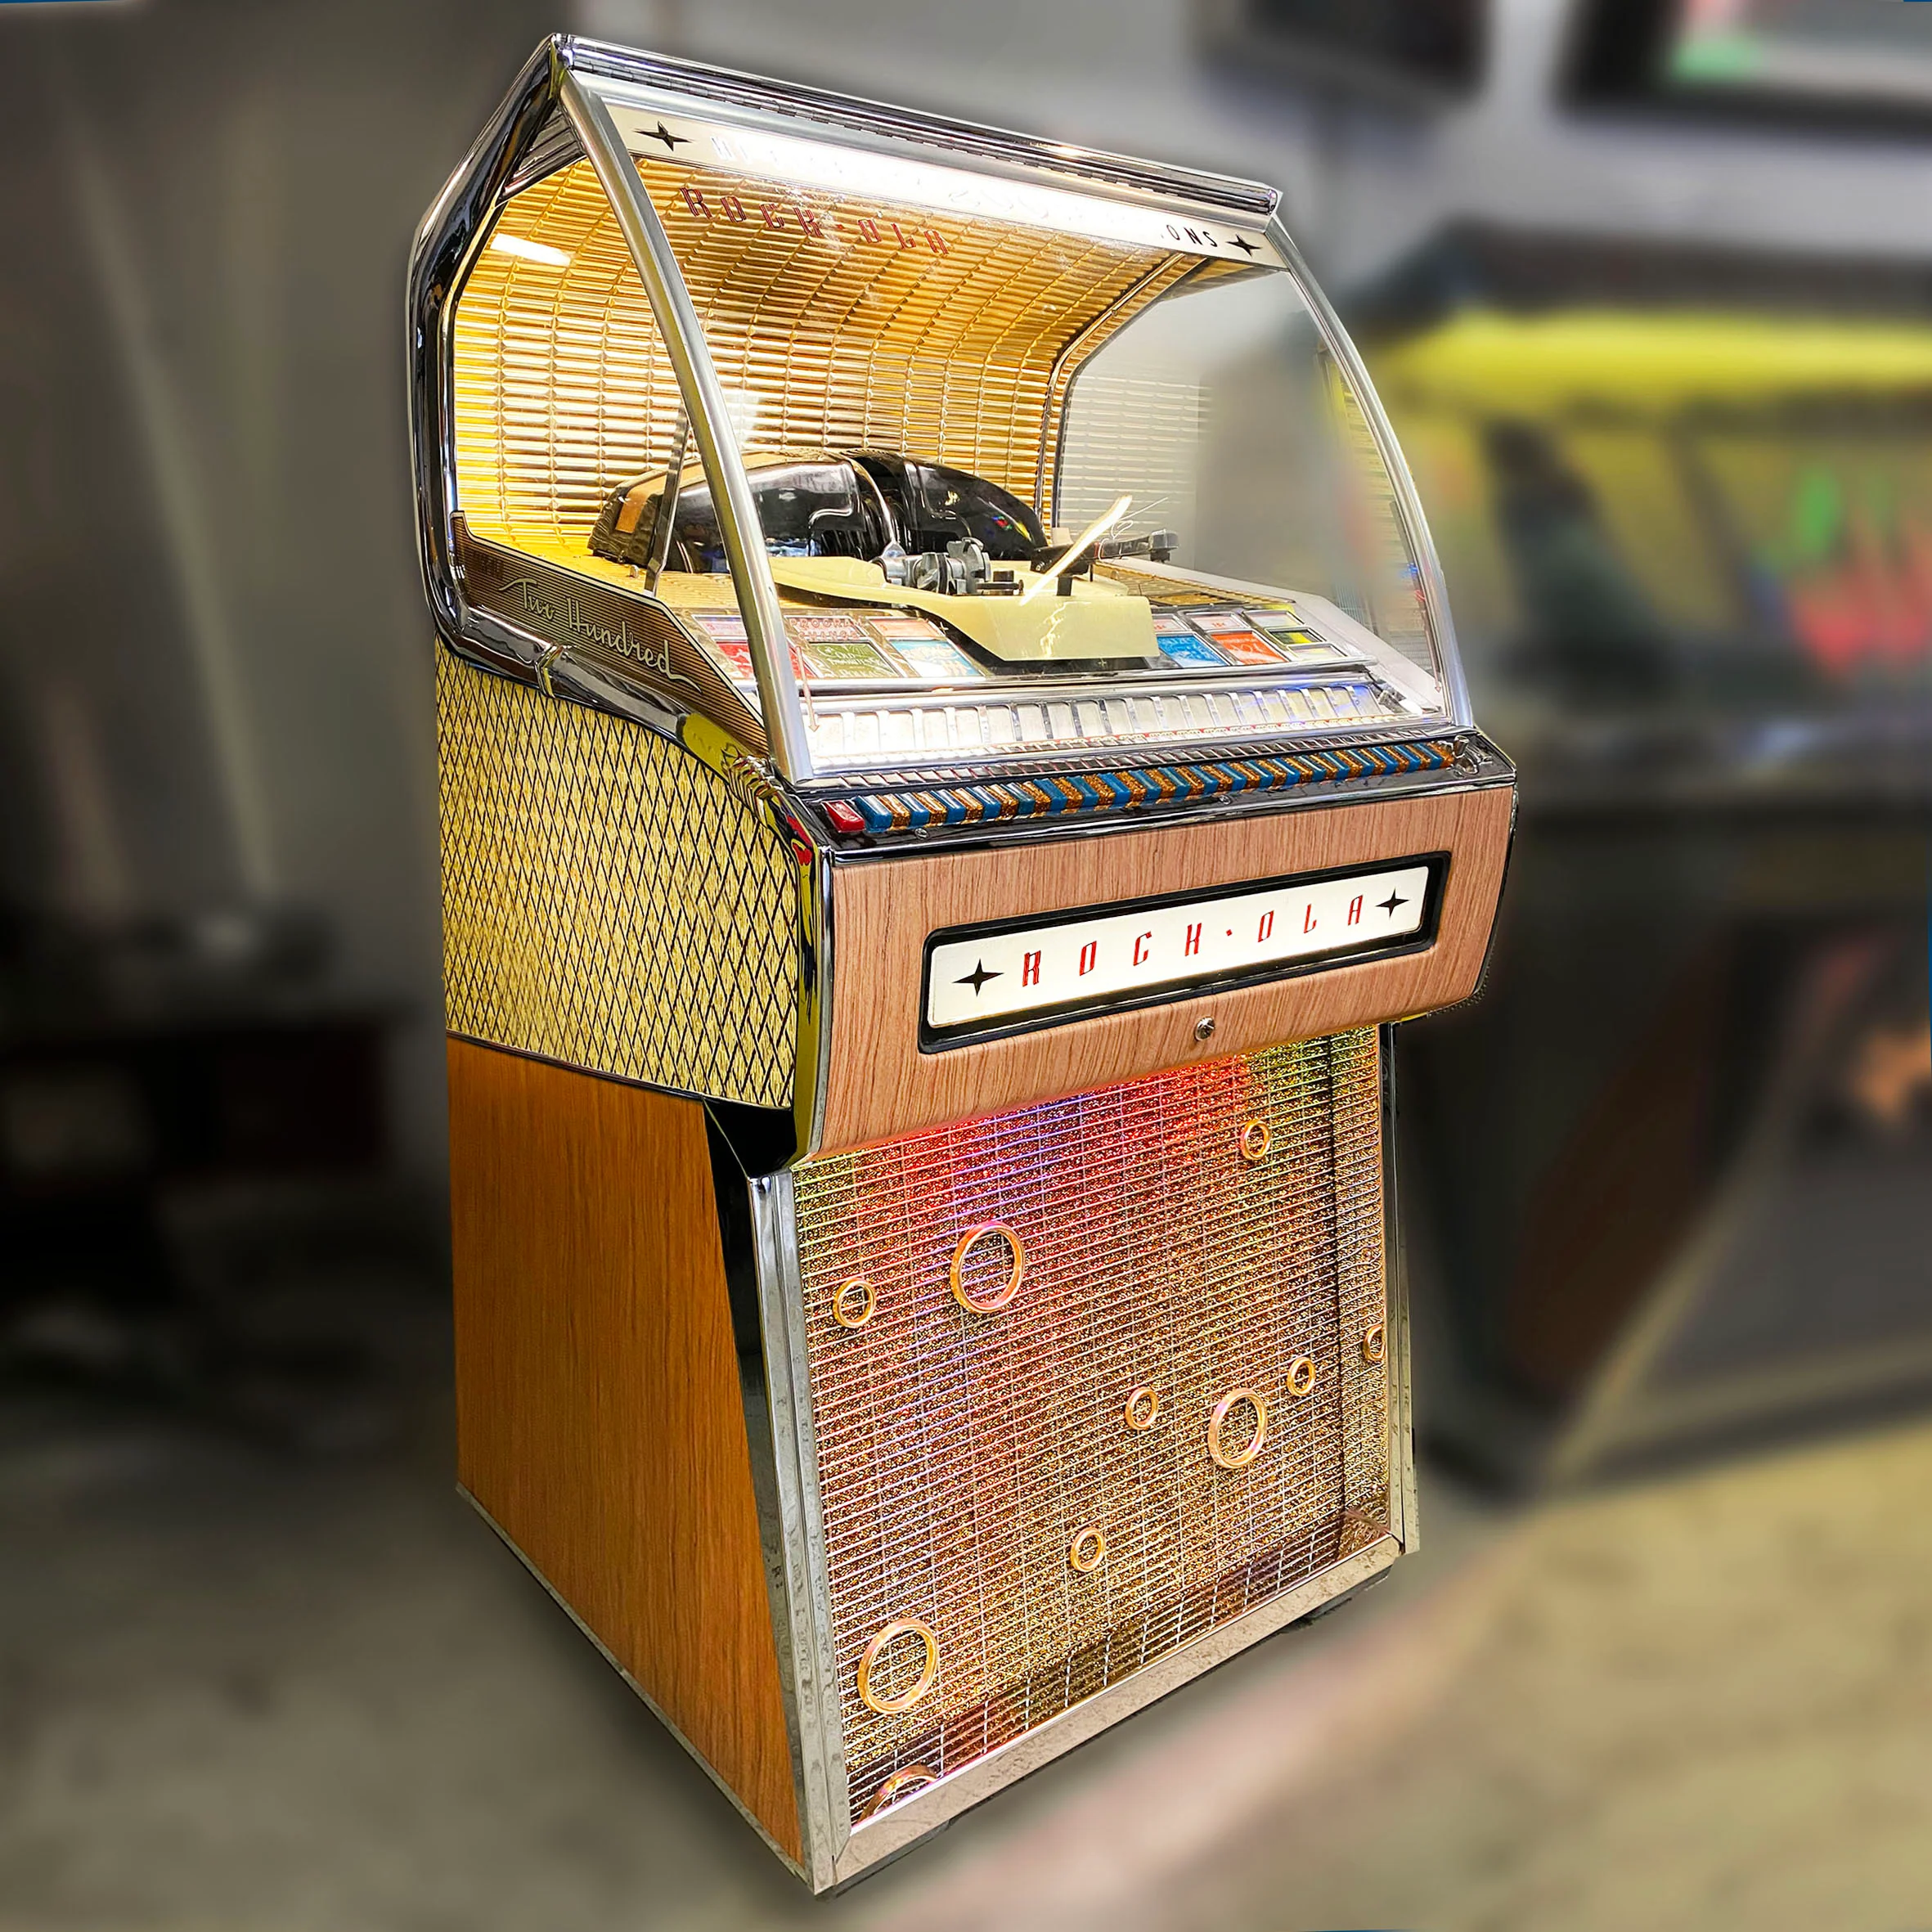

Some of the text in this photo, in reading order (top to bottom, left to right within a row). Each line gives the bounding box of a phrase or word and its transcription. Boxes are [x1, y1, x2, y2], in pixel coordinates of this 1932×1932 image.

[498, 578, 702, 692] Two Hundred
[789, 617, 863, 628] PROGRAM
